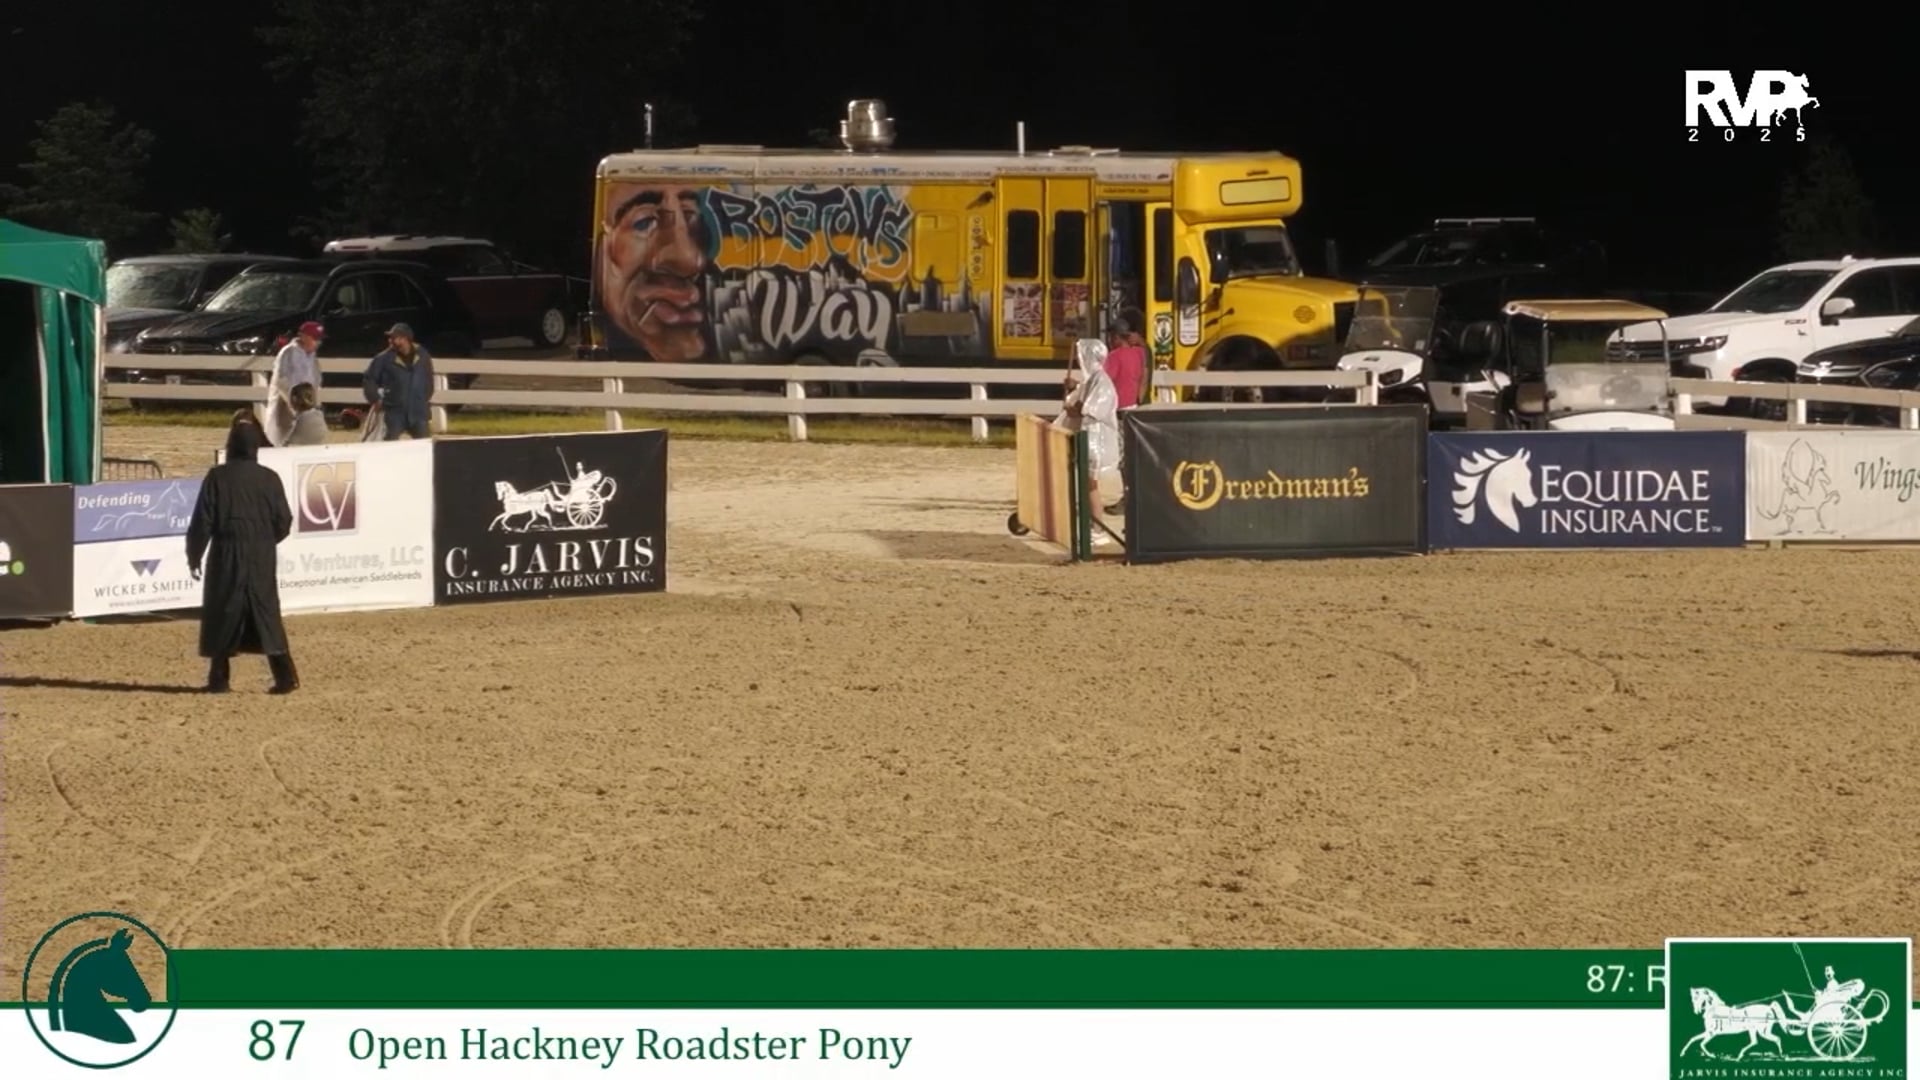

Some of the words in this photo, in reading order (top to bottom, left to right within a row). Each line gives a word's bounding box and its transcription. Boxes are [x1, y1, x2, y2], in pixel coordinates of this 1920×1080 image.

[748, 269, 896, 362] Way
[300, 463, 355, 531] CV
[1173, 460, 1369, 511] Freedman's
[1541, 465, 1710, 508] EQUIDAE
[78, 491, 151, 509] Defending
[1541, 509, 1710, 534] INSURANCE
[300, 552, 385, 573] Ventures,
[390, 545, 424, 567] LLC
[445, 547, 479, 578] C.
[500, 536, 654, 576] JARVIS
[94, 583, 147, 598] WICKER
[152, 579, 193, 593] SMITH
[330, 573, 369, 585] American
[370, 570, 422, 582] Saddlebreds
[447, 577, 544, 596] INSURANCE
[550, 572, 616, 589] AGENCY
[623, 570, 655, 584] INC.
